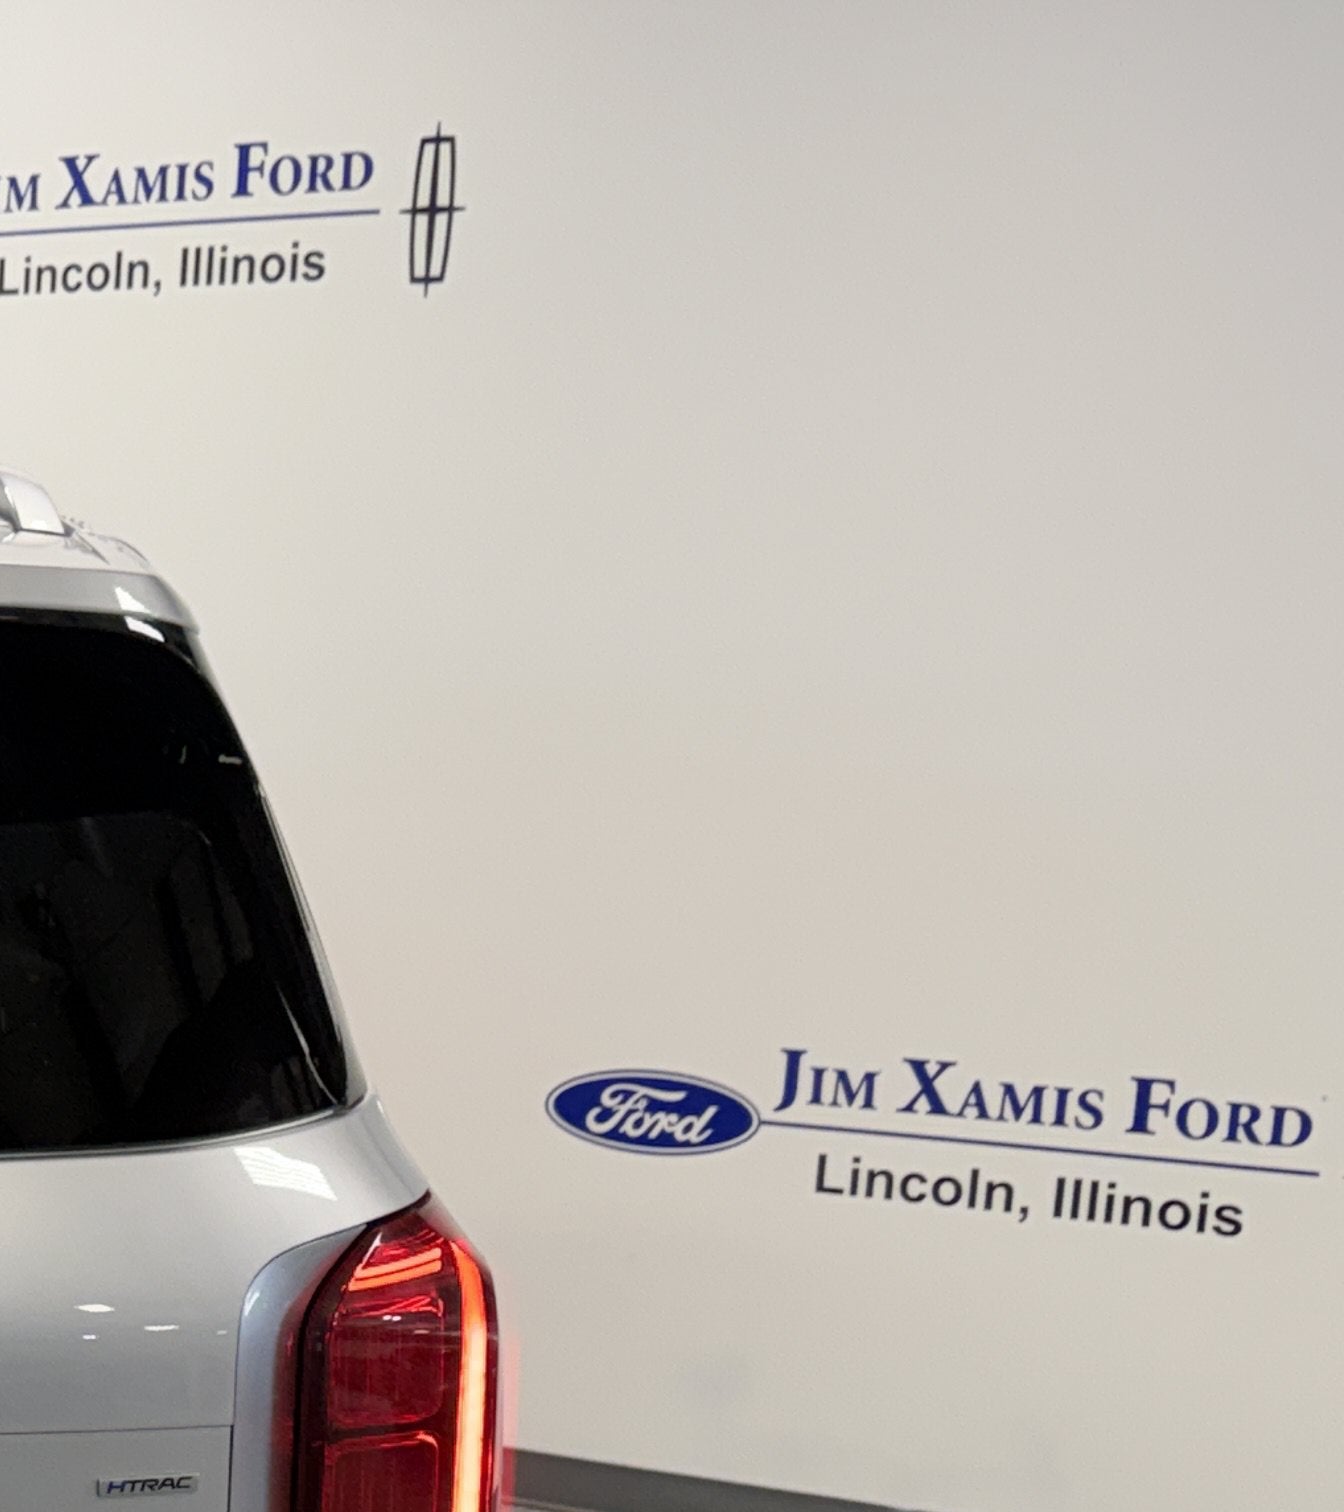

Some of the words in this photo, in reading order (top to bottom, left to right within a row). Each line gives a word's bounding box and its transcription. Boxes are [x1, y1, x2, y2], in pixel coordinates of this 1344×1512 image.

[180, 240, 326, 288] Illinois
[585, 1083, 718, 1146] Ford
[816, 1153, 1030, 1221] Lincoln,
[1053, 1177, 1244, 1238] Illinois
[106, 1476, 193, 1494] HTRAC
